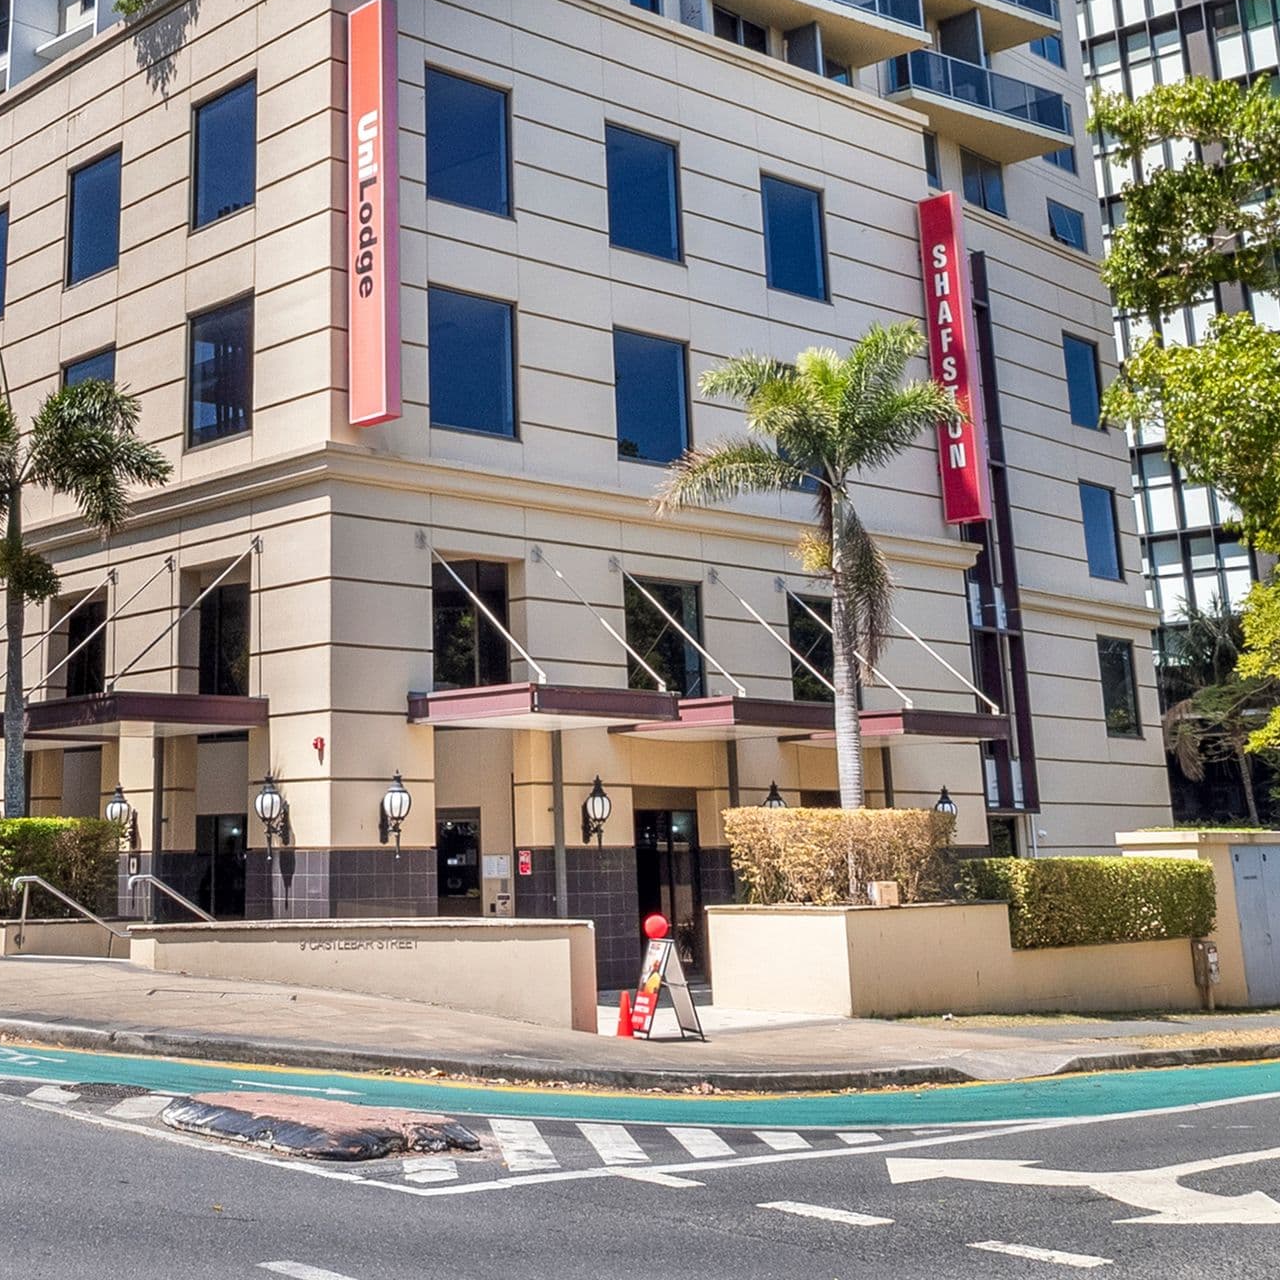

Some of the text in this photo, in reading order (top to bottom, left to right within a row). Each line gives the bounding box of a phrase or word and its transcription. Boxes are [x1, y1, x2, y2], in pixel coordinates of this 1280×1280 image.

[355, 109, 379, 299] UniLodge
[299, 938, 418, 950] 9 CASTLEBAR STREET
